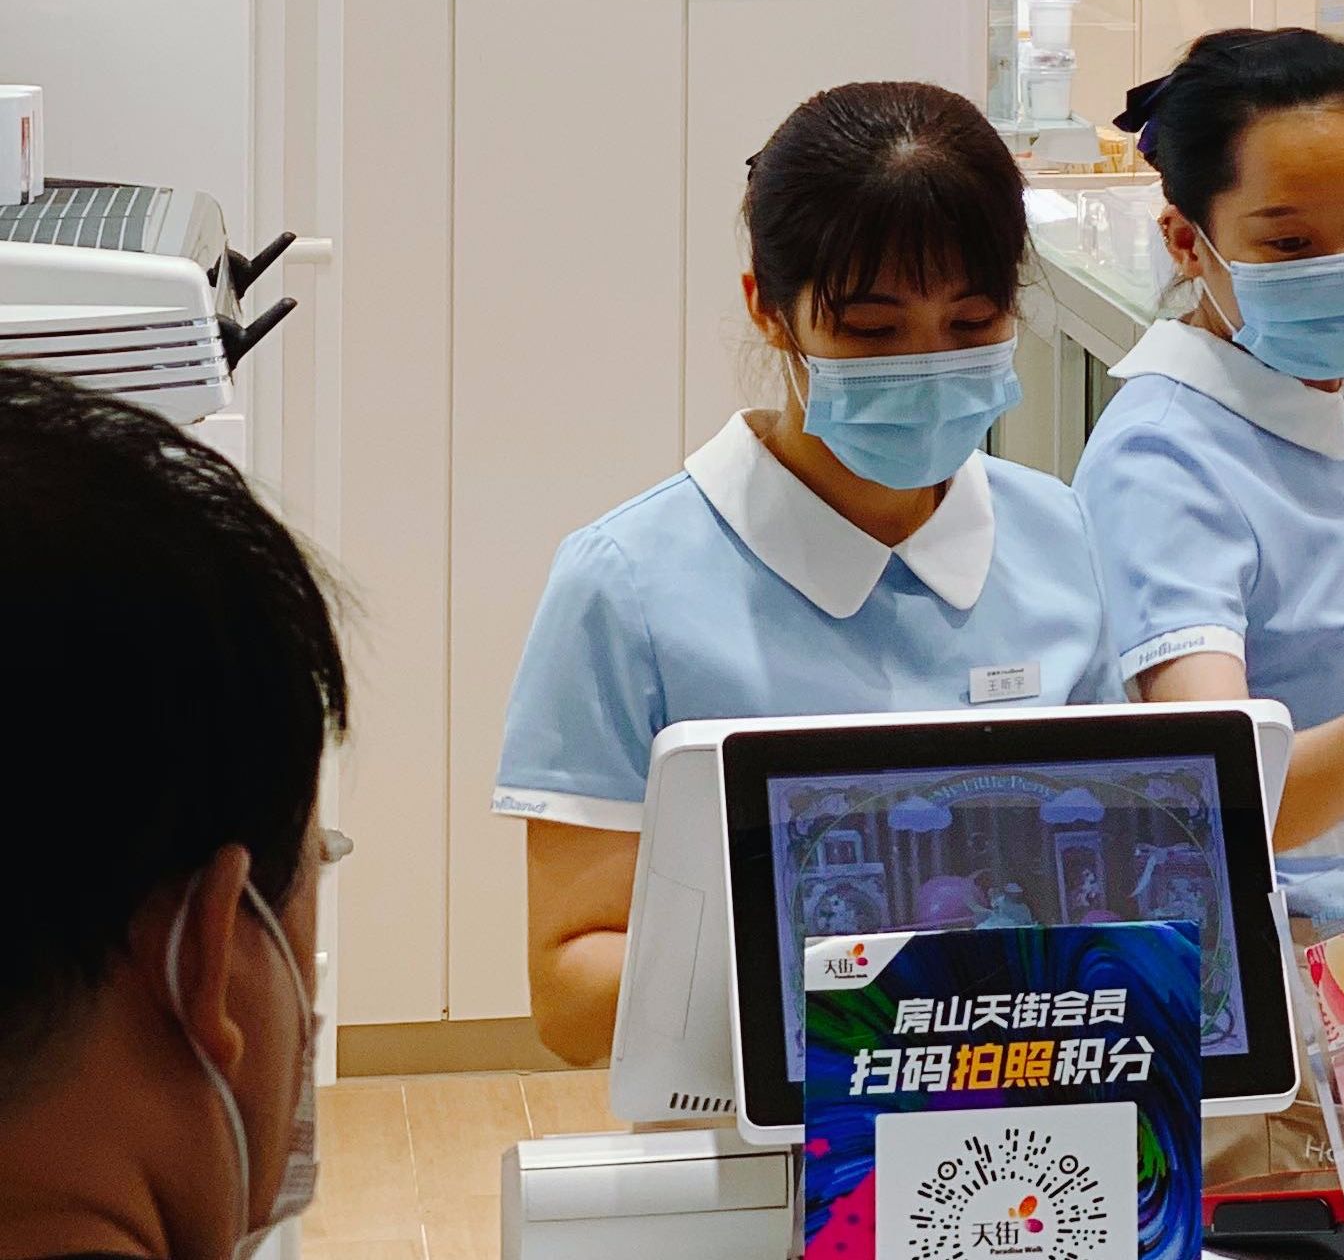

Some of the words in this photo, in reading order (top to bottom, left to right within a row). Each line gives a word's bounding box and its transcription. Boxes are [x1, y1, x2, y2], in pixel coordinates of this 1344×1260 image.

[823, 958, 853, 975] 天街
[893, 988, 1128, 1035] 房山天街会员
[849, 1035, 1156, 1097] 扫码拍照积分
[971, 1220, 1020, 1248] 天街
